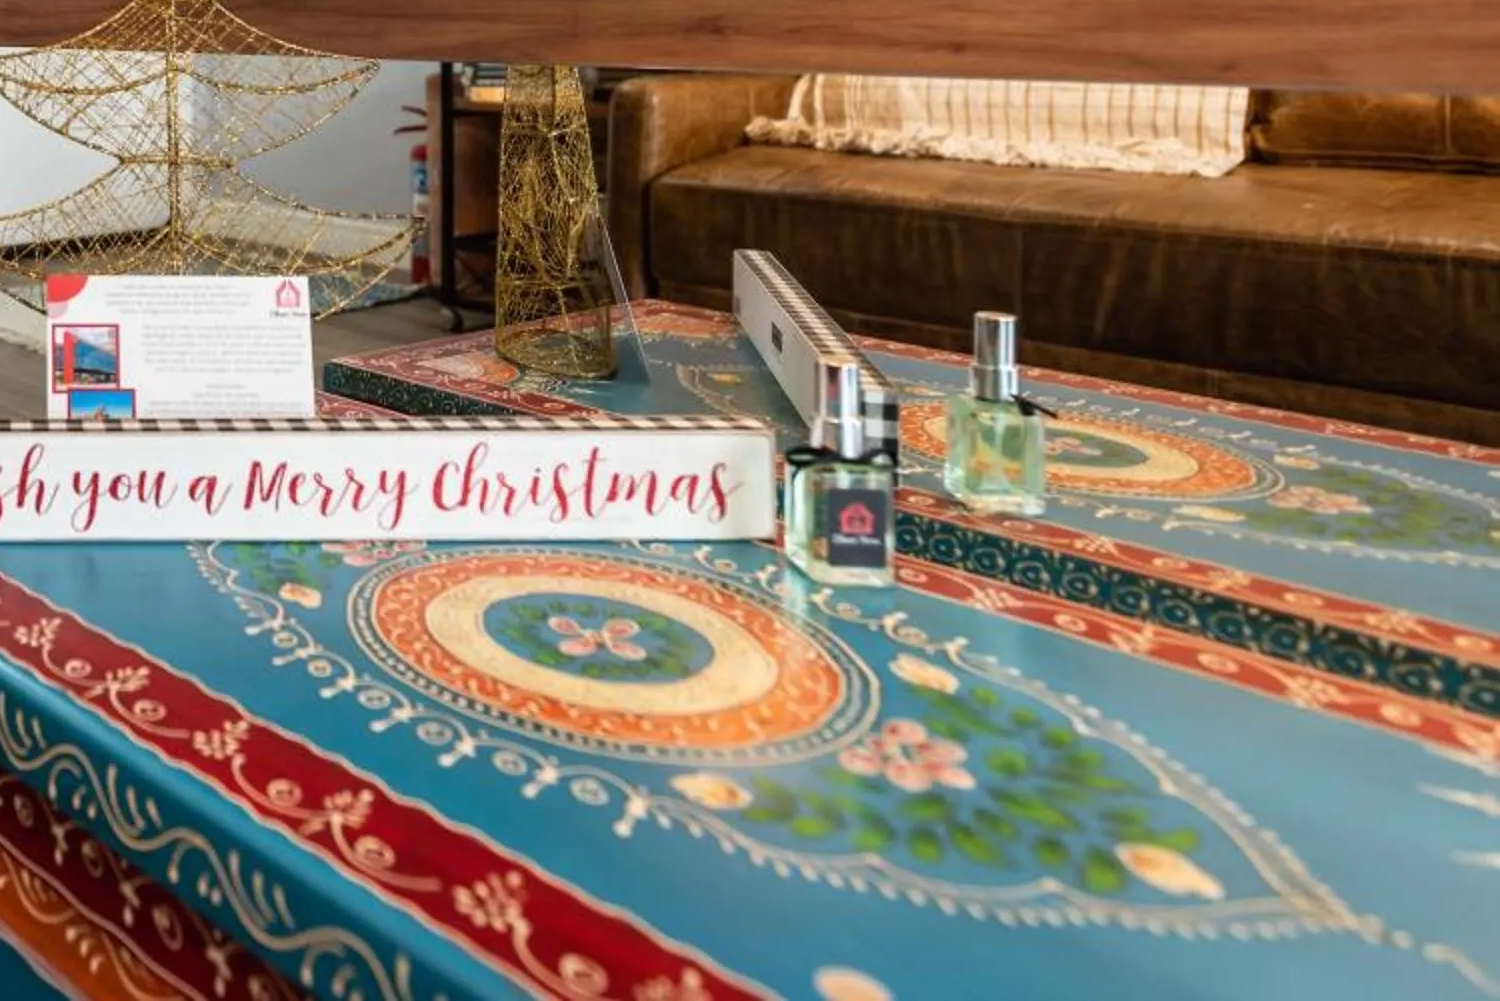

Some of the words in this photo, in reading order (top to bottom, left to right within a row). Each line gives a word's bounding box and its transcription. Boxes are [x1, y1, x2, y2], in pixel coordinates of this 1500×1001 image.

[70, 468, 177, 532] you
[188, 474, 233, 516] a
[243, 460, 412, 531] Merry
[432, 441, 745, 524] Christmas
